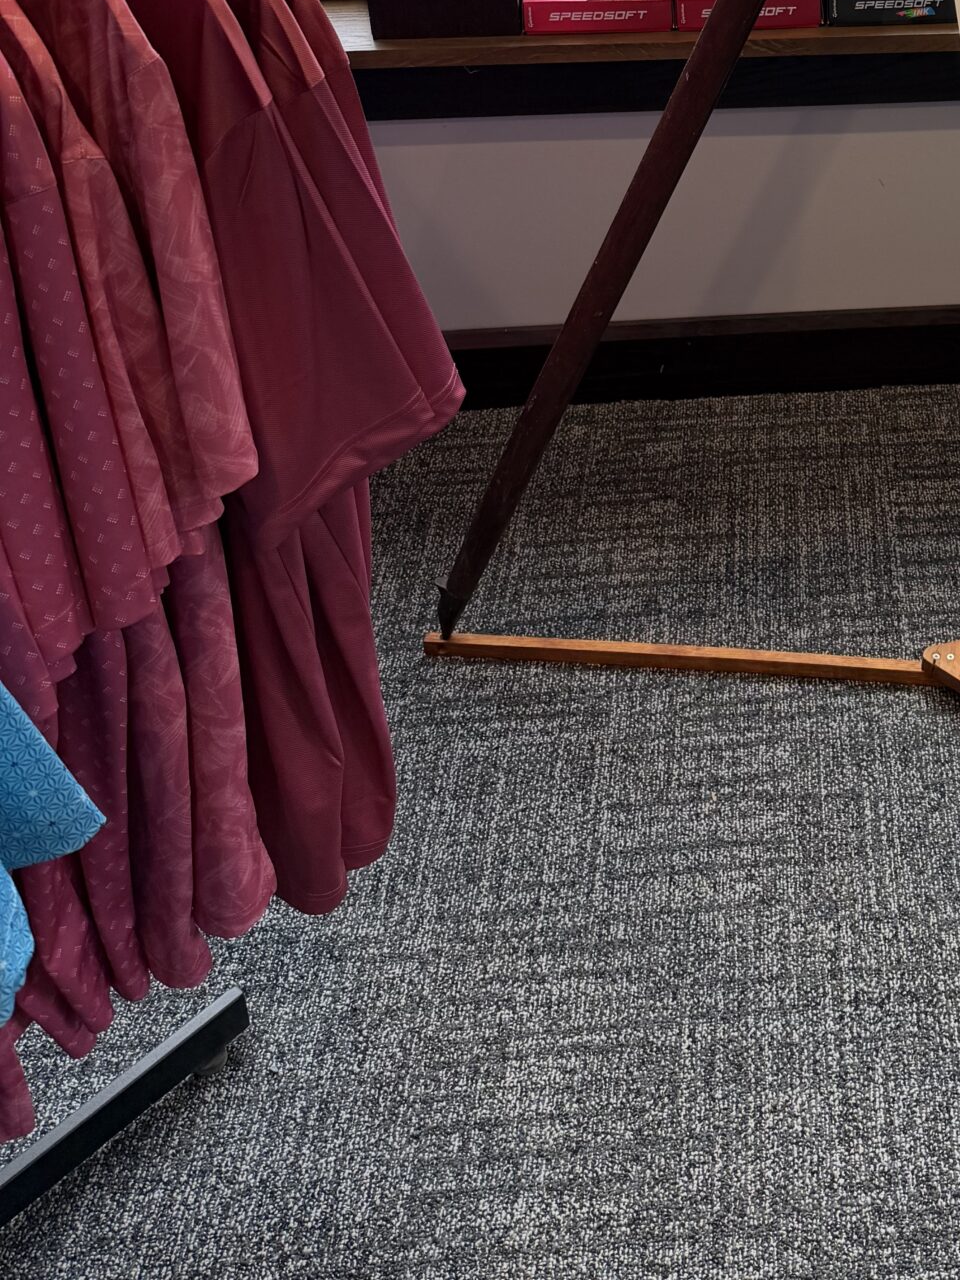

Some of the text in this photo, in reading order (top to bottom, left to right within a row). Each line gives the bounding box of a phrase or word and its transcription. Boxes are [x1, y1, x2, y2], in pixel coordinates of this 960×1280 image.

[854, 0, 944, 10] SPEEDSOFT
[549, 10, 648, 22] SPEEDSOFT
[912, 8, 929, 17] INK
